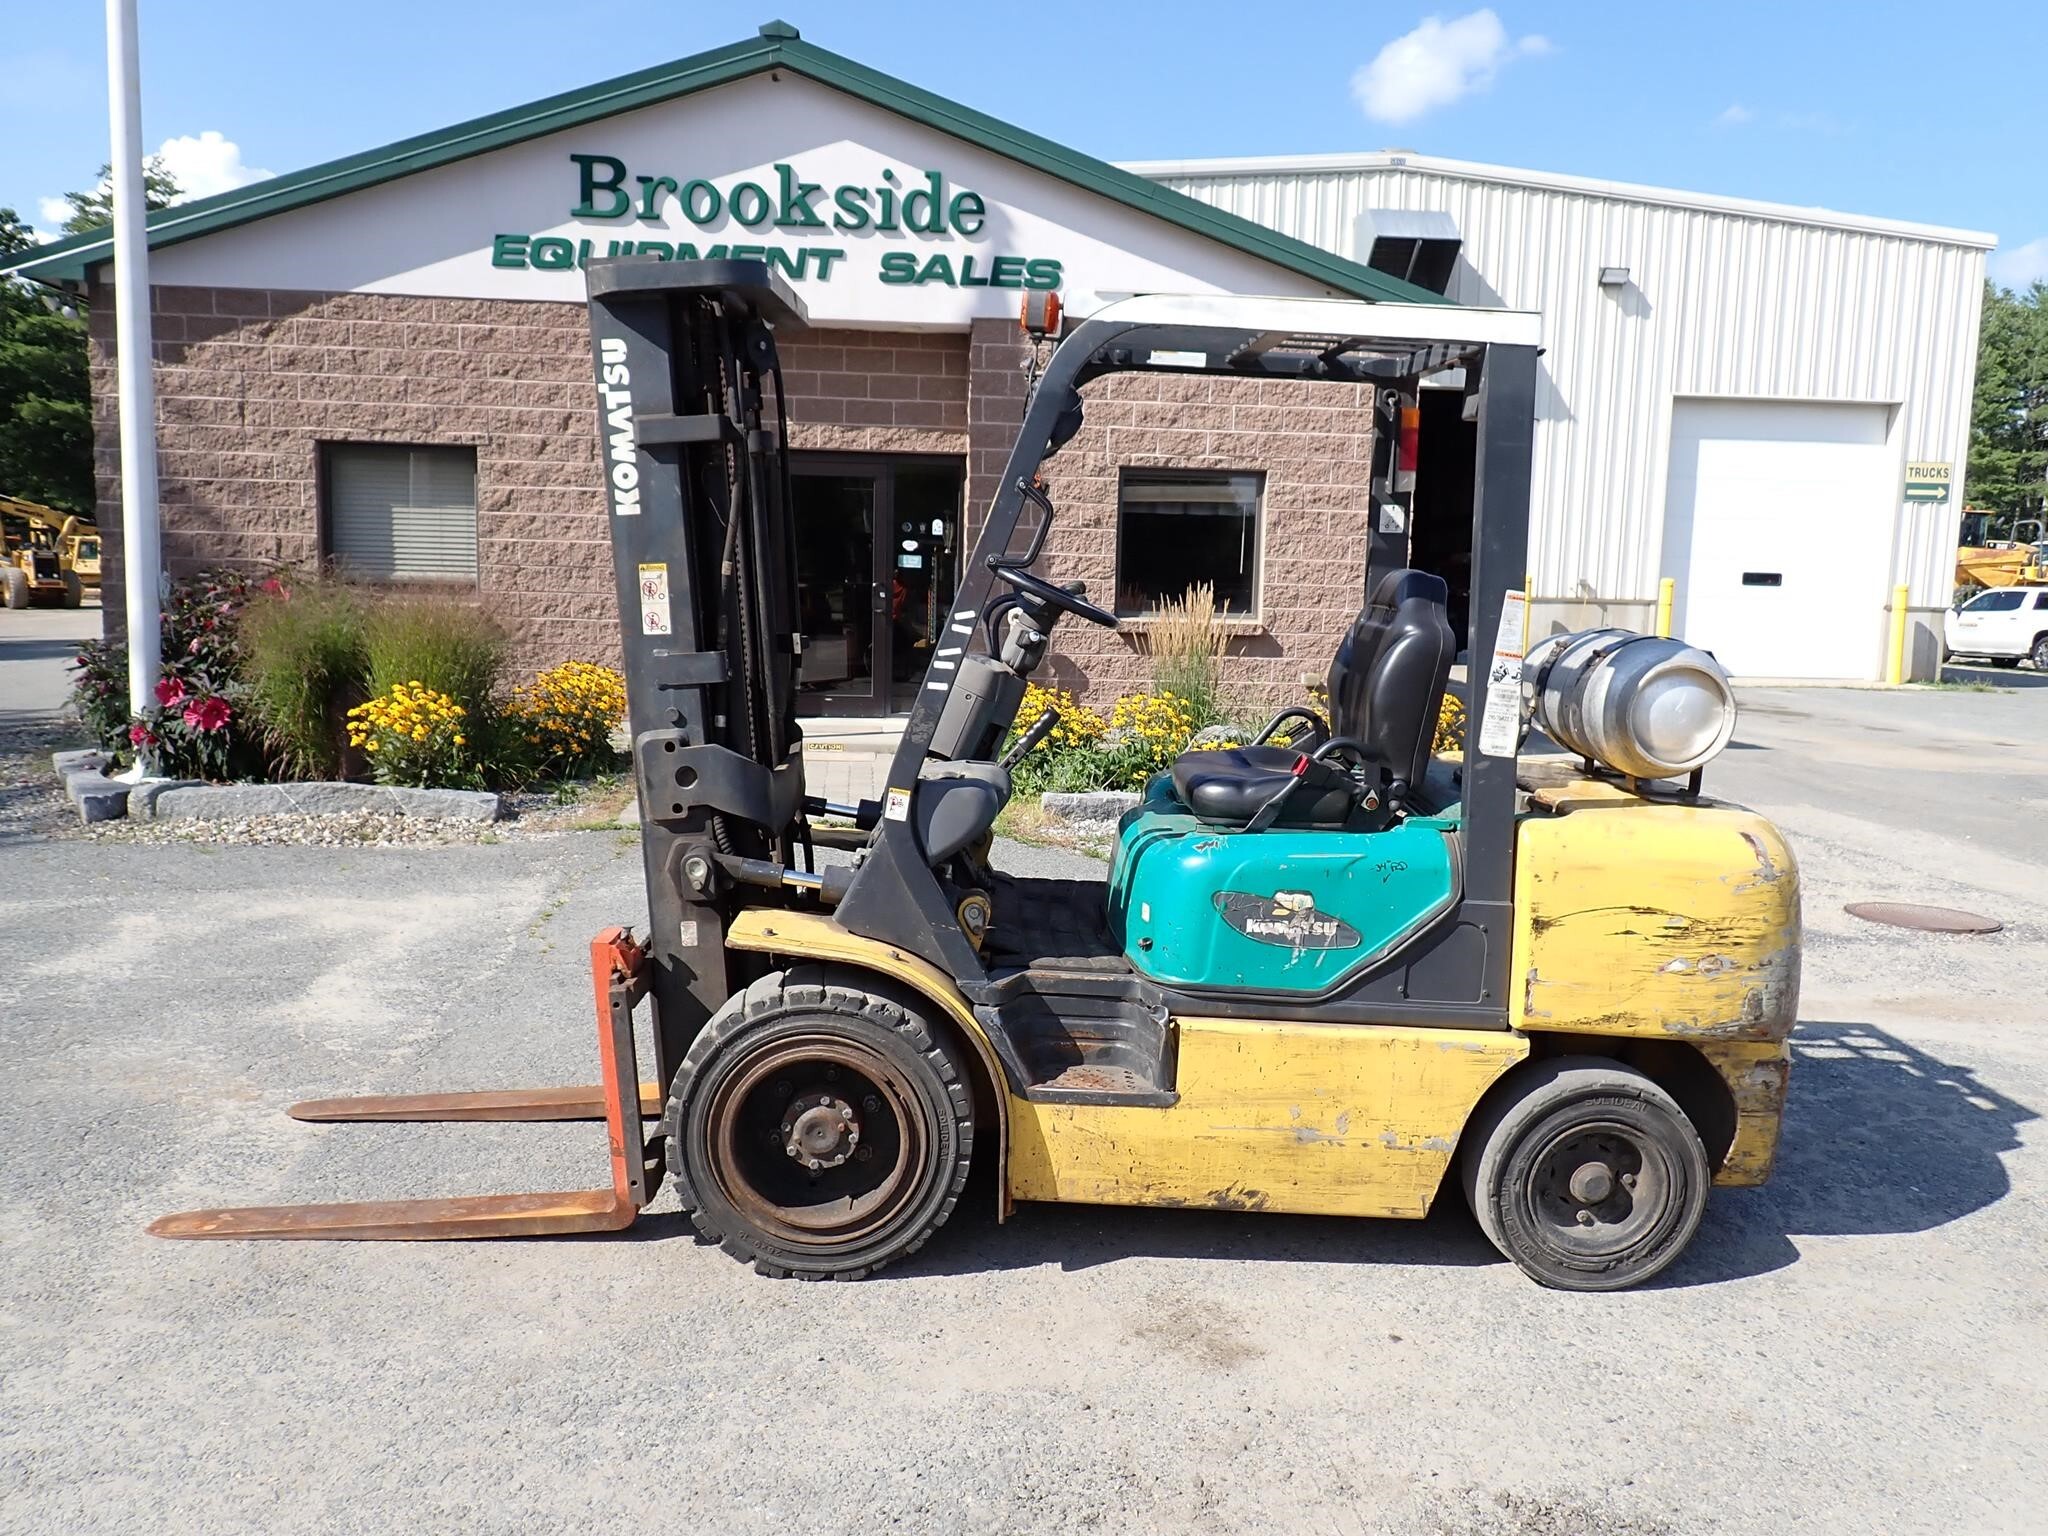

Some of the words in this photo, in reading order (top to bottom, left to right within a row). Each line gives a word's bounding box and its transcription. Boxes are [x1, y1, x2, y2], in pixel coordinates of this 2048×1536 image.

[570, 153, 986, 235] Brookside
[879, 251, 1063, 289] SALES
[597, 338, 641, 516] KOMATSU
[1909, 467, 1949, 478] TRUCKS
[1584, 1097, 1647, 1112] SOLIDEAL
[938, 1109, 950, 1162] SOLIDEAL
